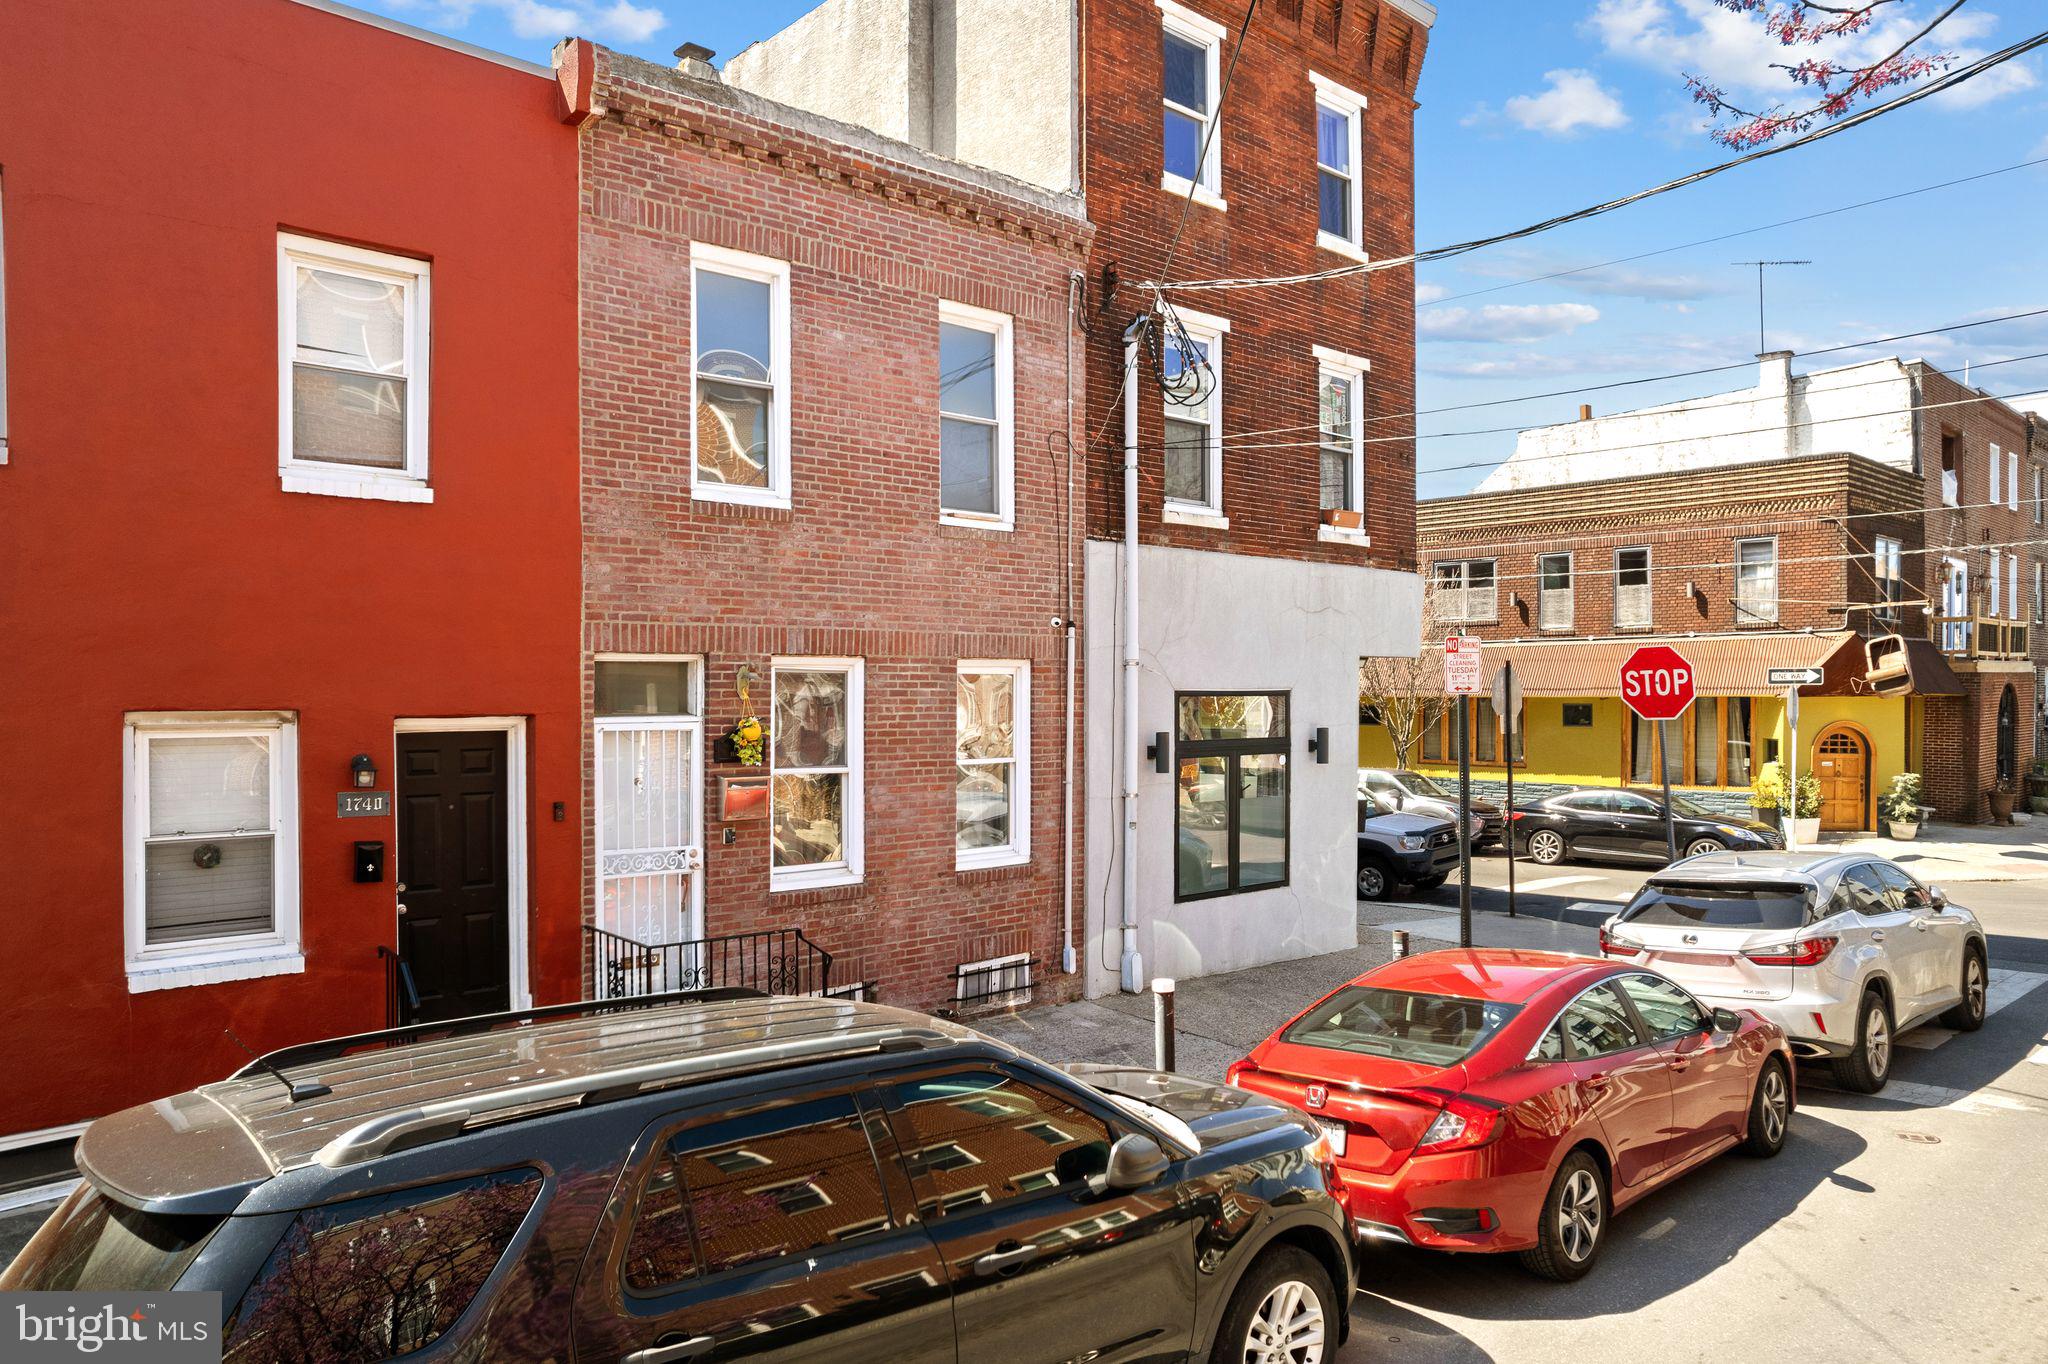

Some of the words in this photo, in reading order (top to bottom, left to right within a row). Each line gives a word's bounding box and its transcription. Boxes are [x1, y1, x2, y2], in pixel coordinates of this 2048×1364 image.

[1447, 640, 1457, 650] NO
[1625, 668, 1689, 697] STOP
[345, 797, 383, 811] 1740
